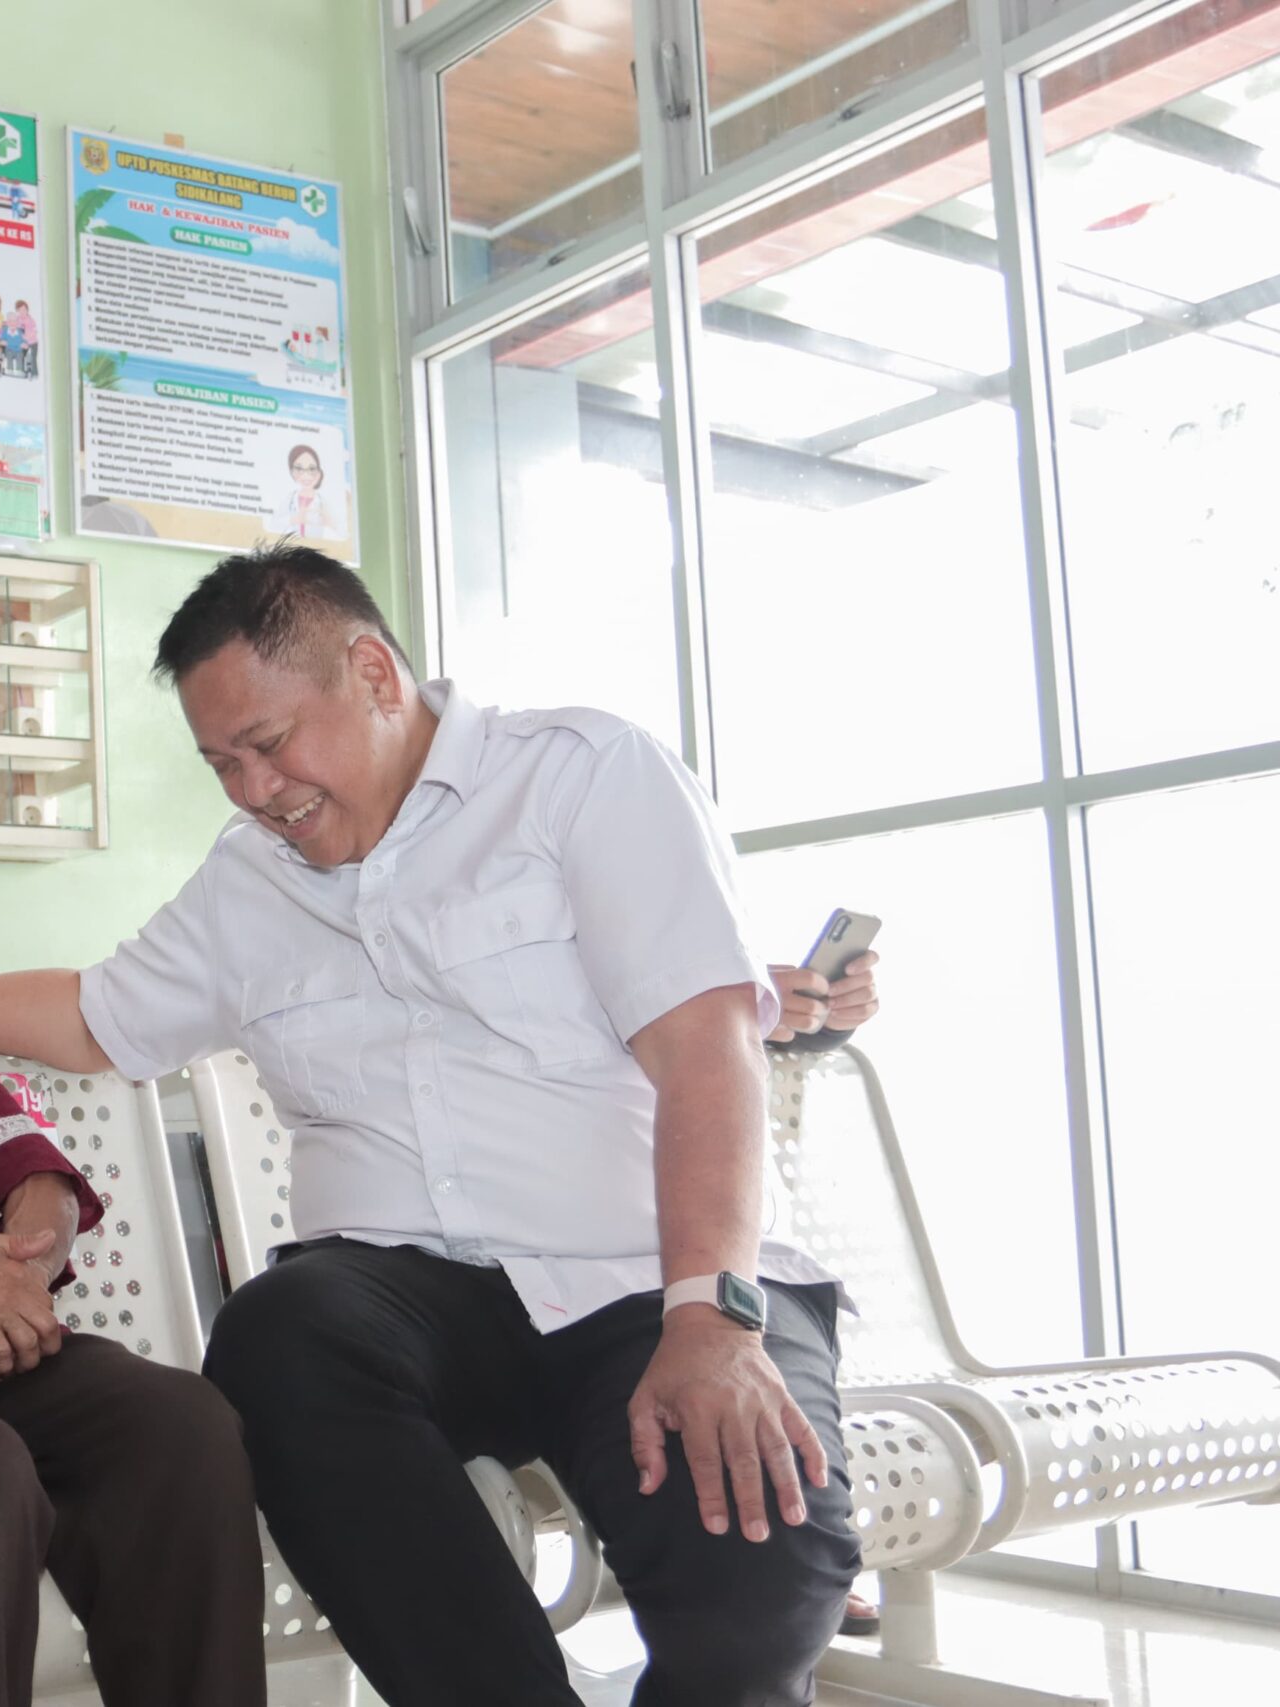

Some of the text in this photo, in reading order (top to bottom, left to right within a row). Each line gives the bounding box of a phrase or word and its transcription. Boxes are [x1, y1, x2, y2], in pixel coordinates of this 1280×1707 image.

[116, 151, 297, 203] UPTD PUSKESMAS BATANG BERUH
[175, 181, 243, 210] SIDIKALANG
[128, 200, 290, 240] HAK & KEWAJIBAN PASIEN
[174, 228, 248, 252] HAK PASIEN
[157, 382, 276, 411] KEWAJIBAN PASIEN
